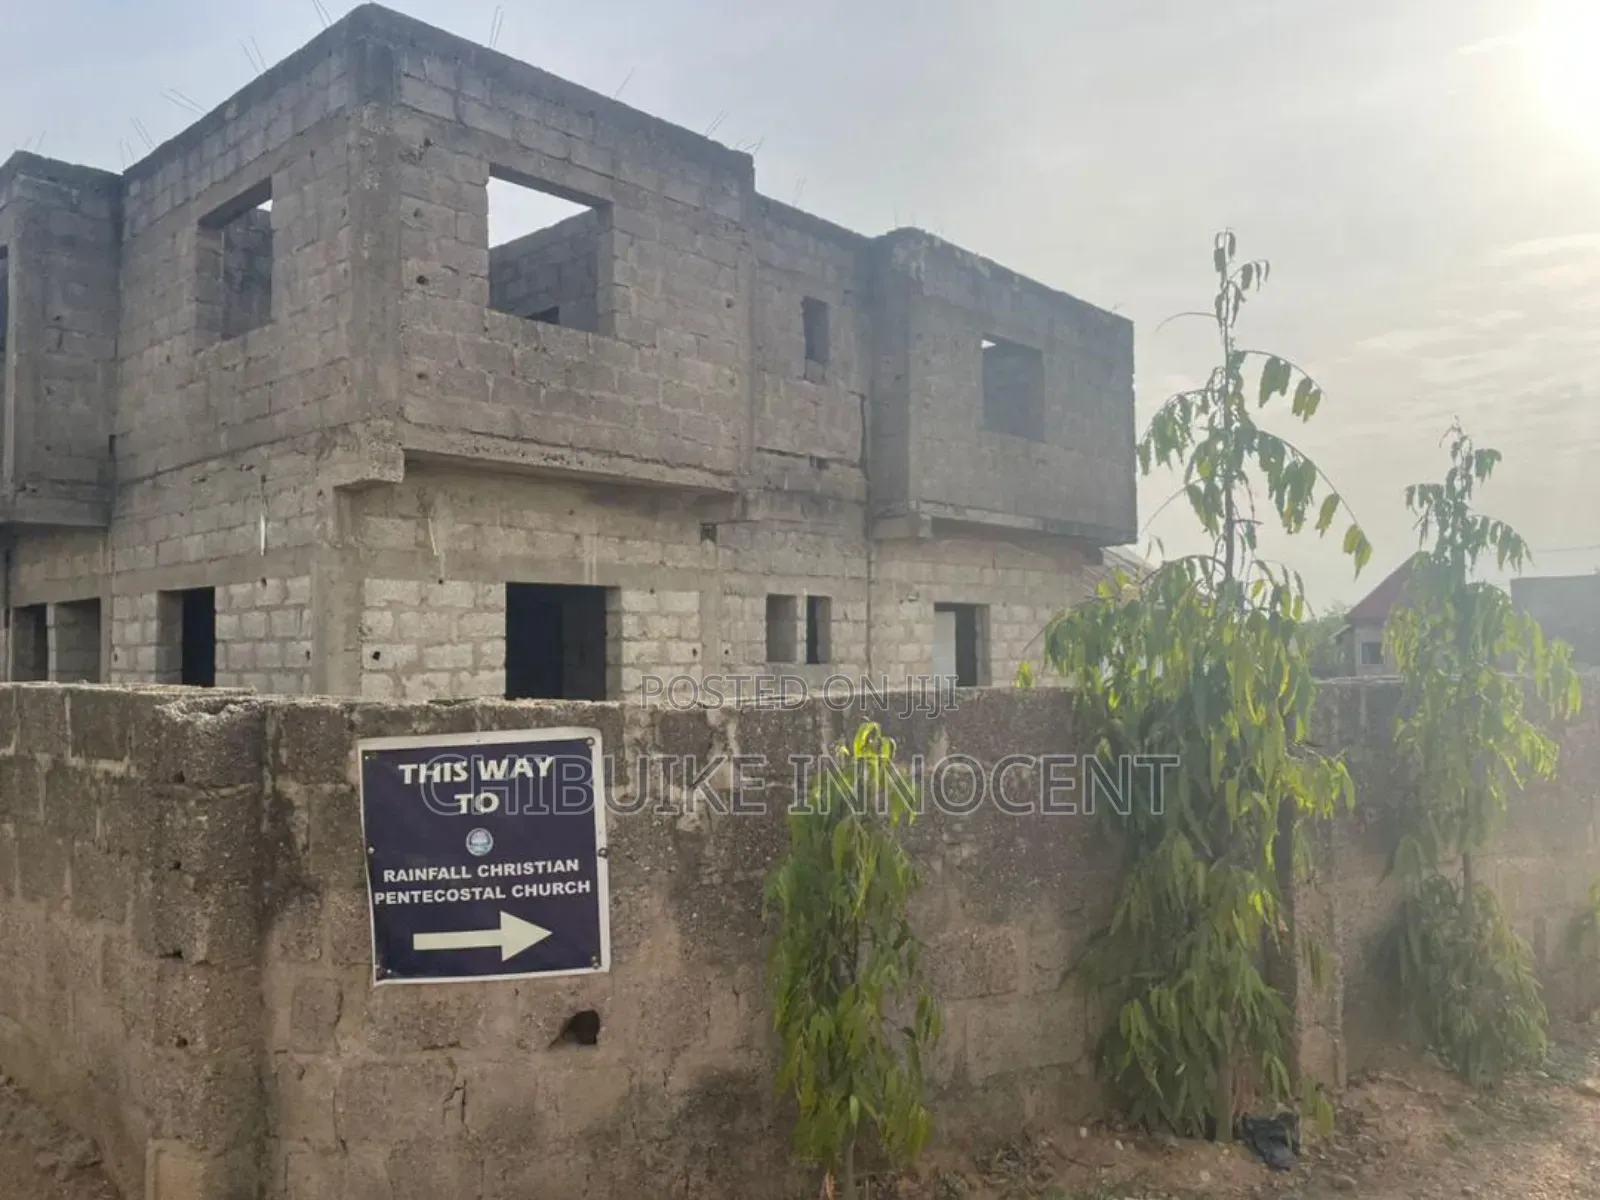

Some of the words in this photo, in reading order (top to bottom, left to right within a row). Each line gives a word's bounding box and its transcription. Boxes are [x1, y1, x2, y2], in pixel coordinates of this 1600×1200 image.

[398, 760, 468, 785] THIS
[477, 756, 555, 781] WAY
[454, 792, 500, 815] TO
[383, 866, 472, 882] RAINFALL
[477, 858, 580, 878] CHRISTIAN
[374, 886, 506, 905] PENTECOSTAL
[511, 879, 592, 898] CHURCH
